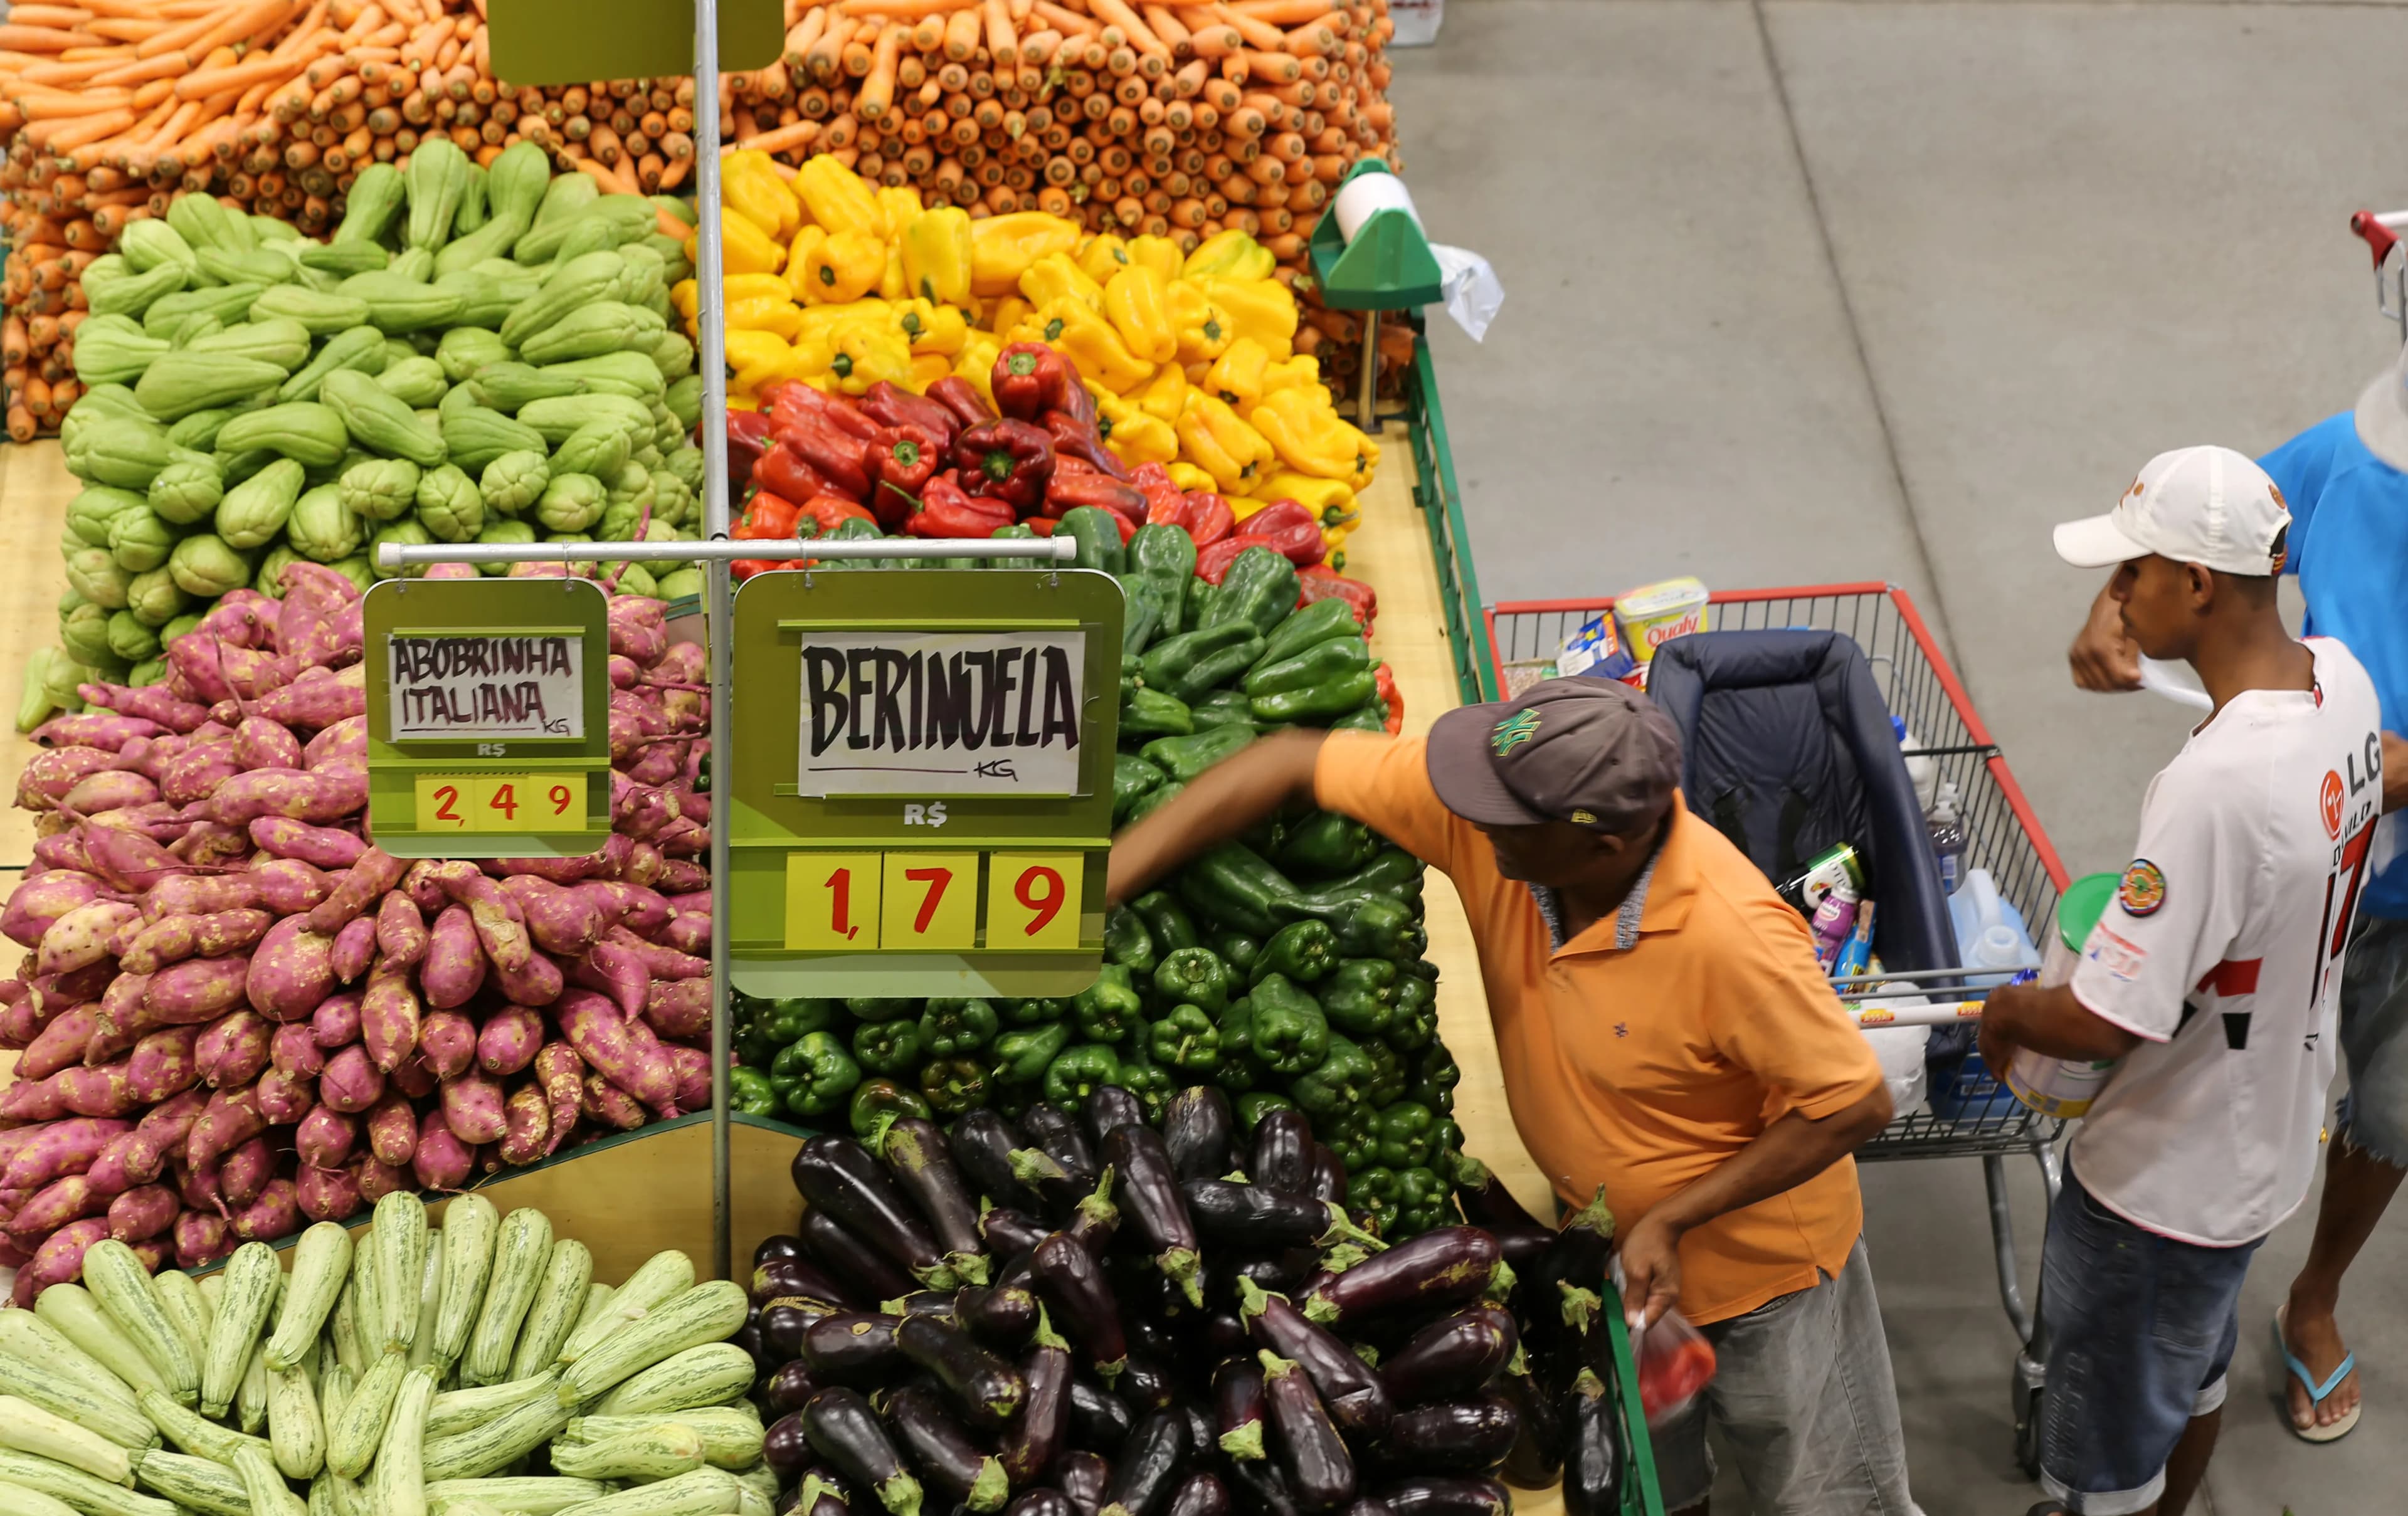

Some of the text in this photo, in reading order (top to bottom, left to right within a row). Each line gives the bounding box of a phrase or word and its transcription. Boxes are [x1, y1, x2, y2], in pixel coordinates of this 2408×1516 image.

[390, 637, 573, 685] ABOBRINHA
[401, 681, 547, 725] ITALIANA
[801, 645, 1080, 757] BERINJELA
[541, 718, 570, 737] KG
[477, 744, 506, 757] R$
[2347, 731, 2382, 797] LG
[973, 759, 1019, 782] KG
[903, 801, 948, 828] R$
